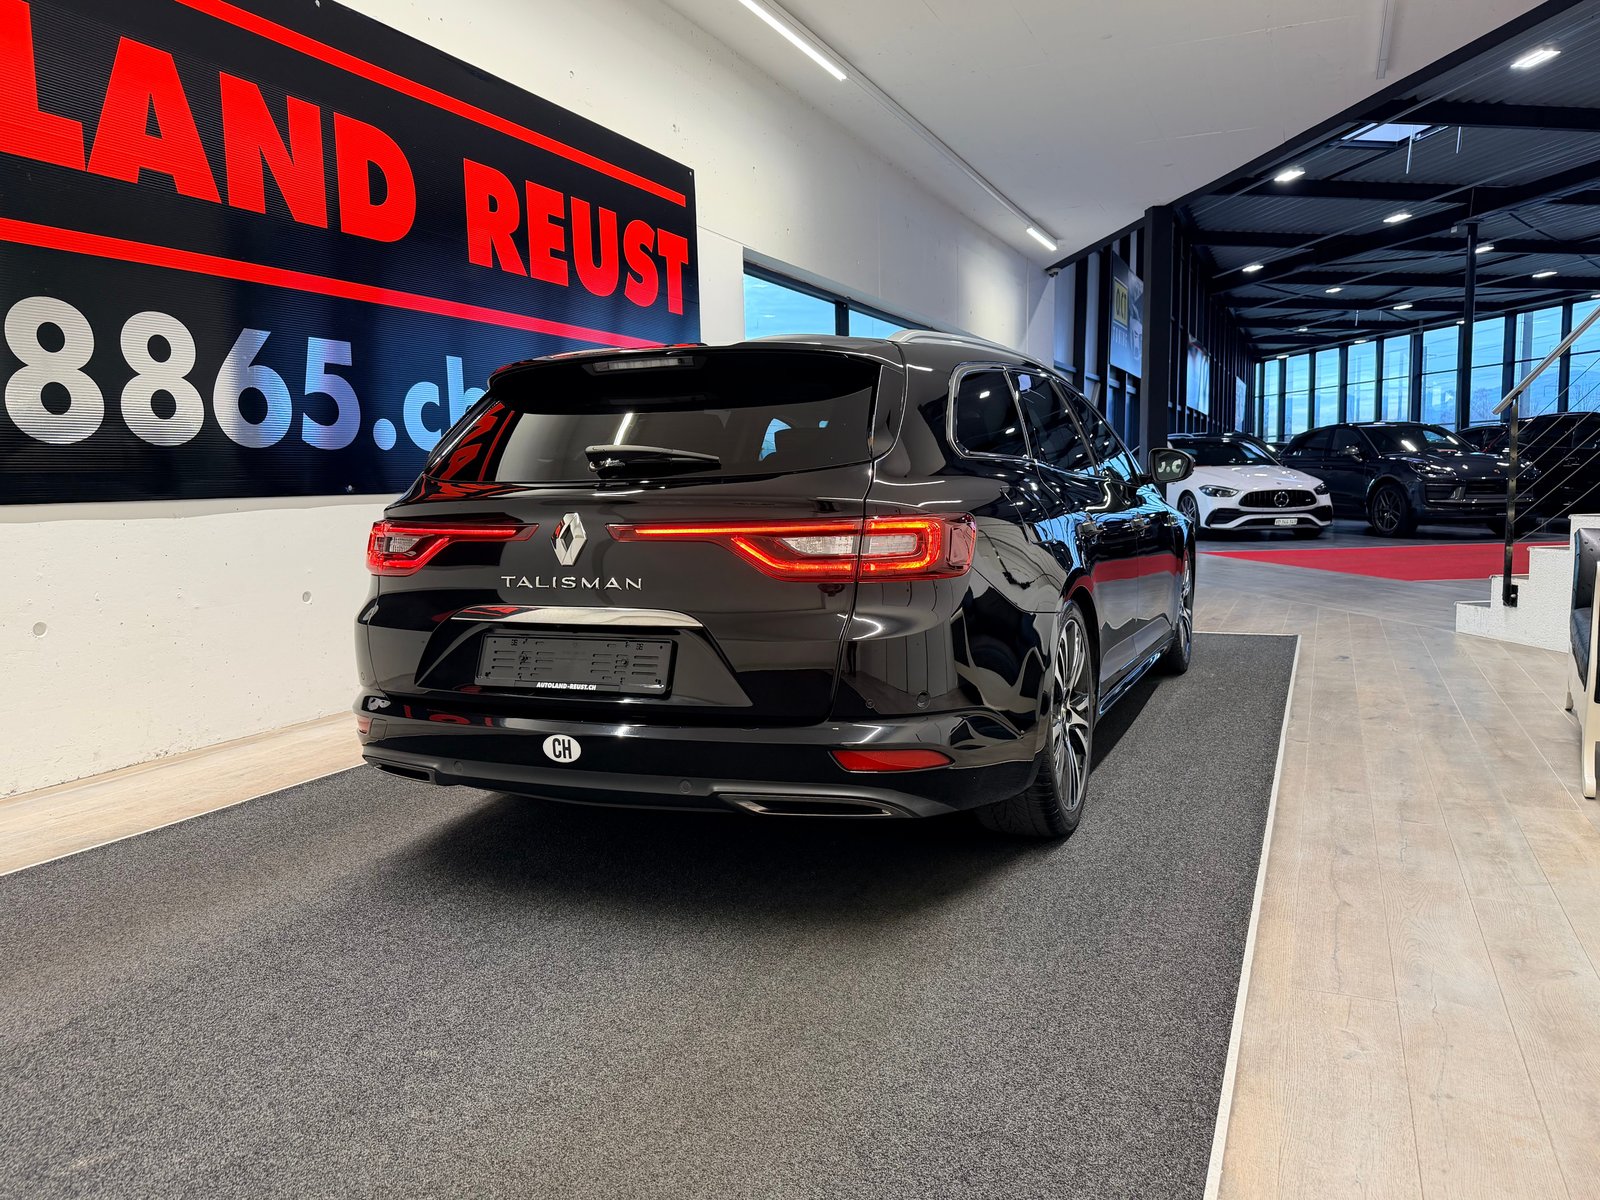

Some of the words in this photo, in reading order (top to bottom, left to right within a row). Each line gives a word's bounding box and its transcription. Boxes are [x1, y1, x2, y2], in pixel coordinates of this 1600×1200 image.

[463, 157, 688, 315] REUST
[501, 575, 642, 591] TALISMAN
[536, 681, 597, 691] AUTOLAND-REUST.CH
[551, 737, 573, 760] CH
